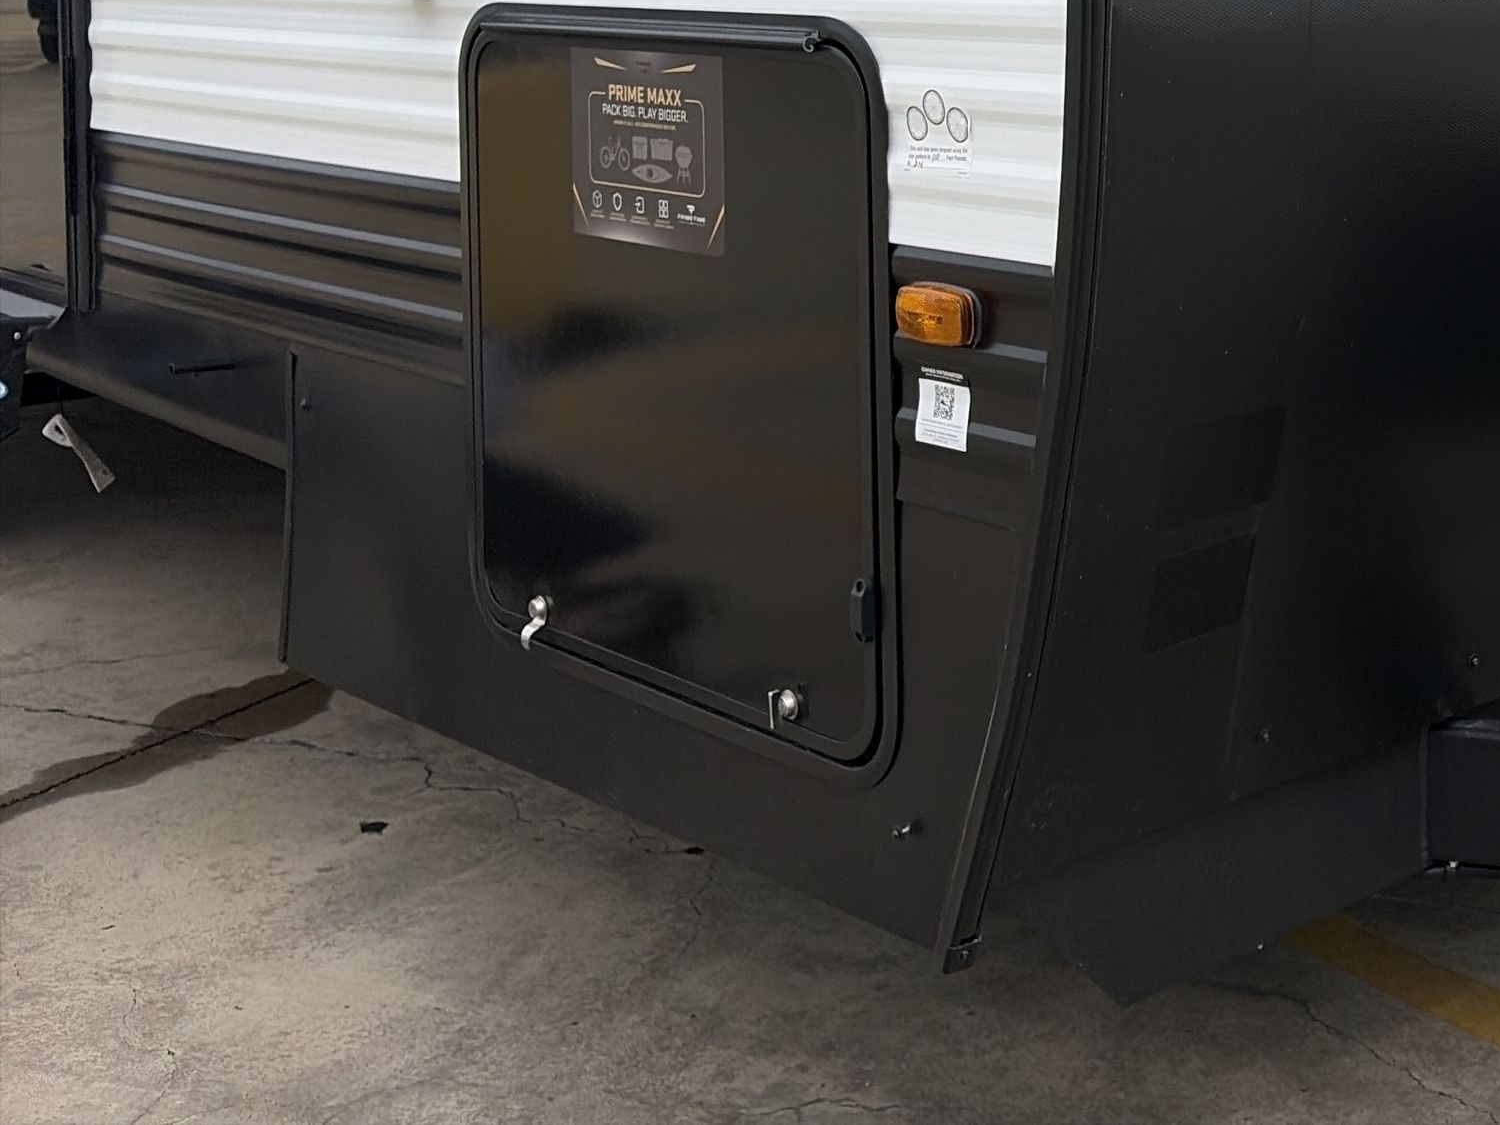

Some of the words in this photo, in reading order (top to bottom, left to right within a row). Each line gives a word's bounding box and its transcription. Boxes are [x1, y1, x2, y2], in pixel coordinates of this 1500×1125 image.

[608, 83, 645, 104] PRIME
[647, 87, 682, 107] MAXX
[602, 103, 621, 116] PACK
[638, 106, 658, 120] PLAY
[658, 108, 689, 123] BIGGER.
